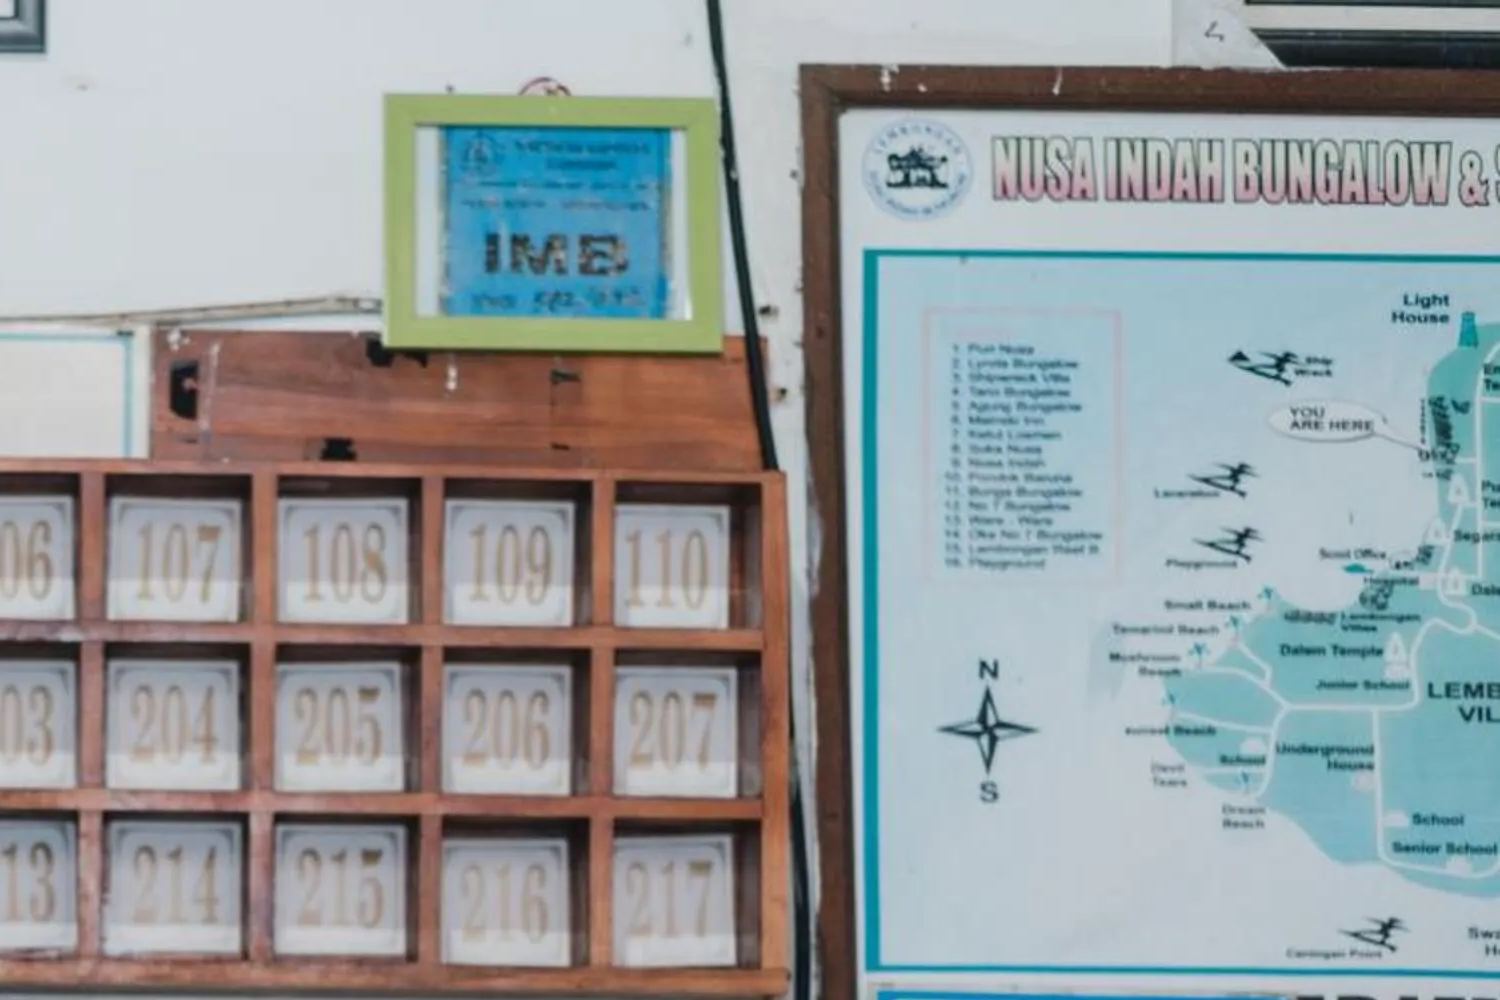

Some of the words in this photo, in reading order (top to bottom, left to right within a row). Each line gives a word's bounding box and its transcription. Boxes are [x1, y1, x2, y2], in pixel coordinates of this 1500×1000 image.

[991, 136, 1098, 201] NUSA
[1103, 137, 1224, 203] INDAH
[1233, 139, 1454, 206] BUNGALOW
[1458, 151, 1490, 206] &
[484, 233, 629, 277] IMB
[1391, 311, 1450, 324] House
[1402, 294, 1450, 309] Light
[1289, 406, 1325, 418] YOU
[1290, 420, 1321, 432] ARE
[1329, 420, 1375, 432] HERE
[134, 524, 222, 605] 107
[301, 523, 389, 604] 108
[466, 525, 555, 605] 109
[624, 527, 710, 612] 110
[978, 659, 999, 680] N
[129, 684, 218, 764] 204
[294, 686, 382, 768] 205
[460, 689, 550, 770] 206
[629, 690, 717, 771] 207
[979, 782, 999, 803] S
[1327, 758, 1375, 771] House
[1392, 842, 1441, 855] Senior
[1446, 842, 1498, 856] School
[1411, 813, 1464, 827] School
[131, 844, 219, 926] 214
[295, 847, 384, 930] 215
[460, 862, 549, 943] 216
[625, 859, 713, 940] 217
